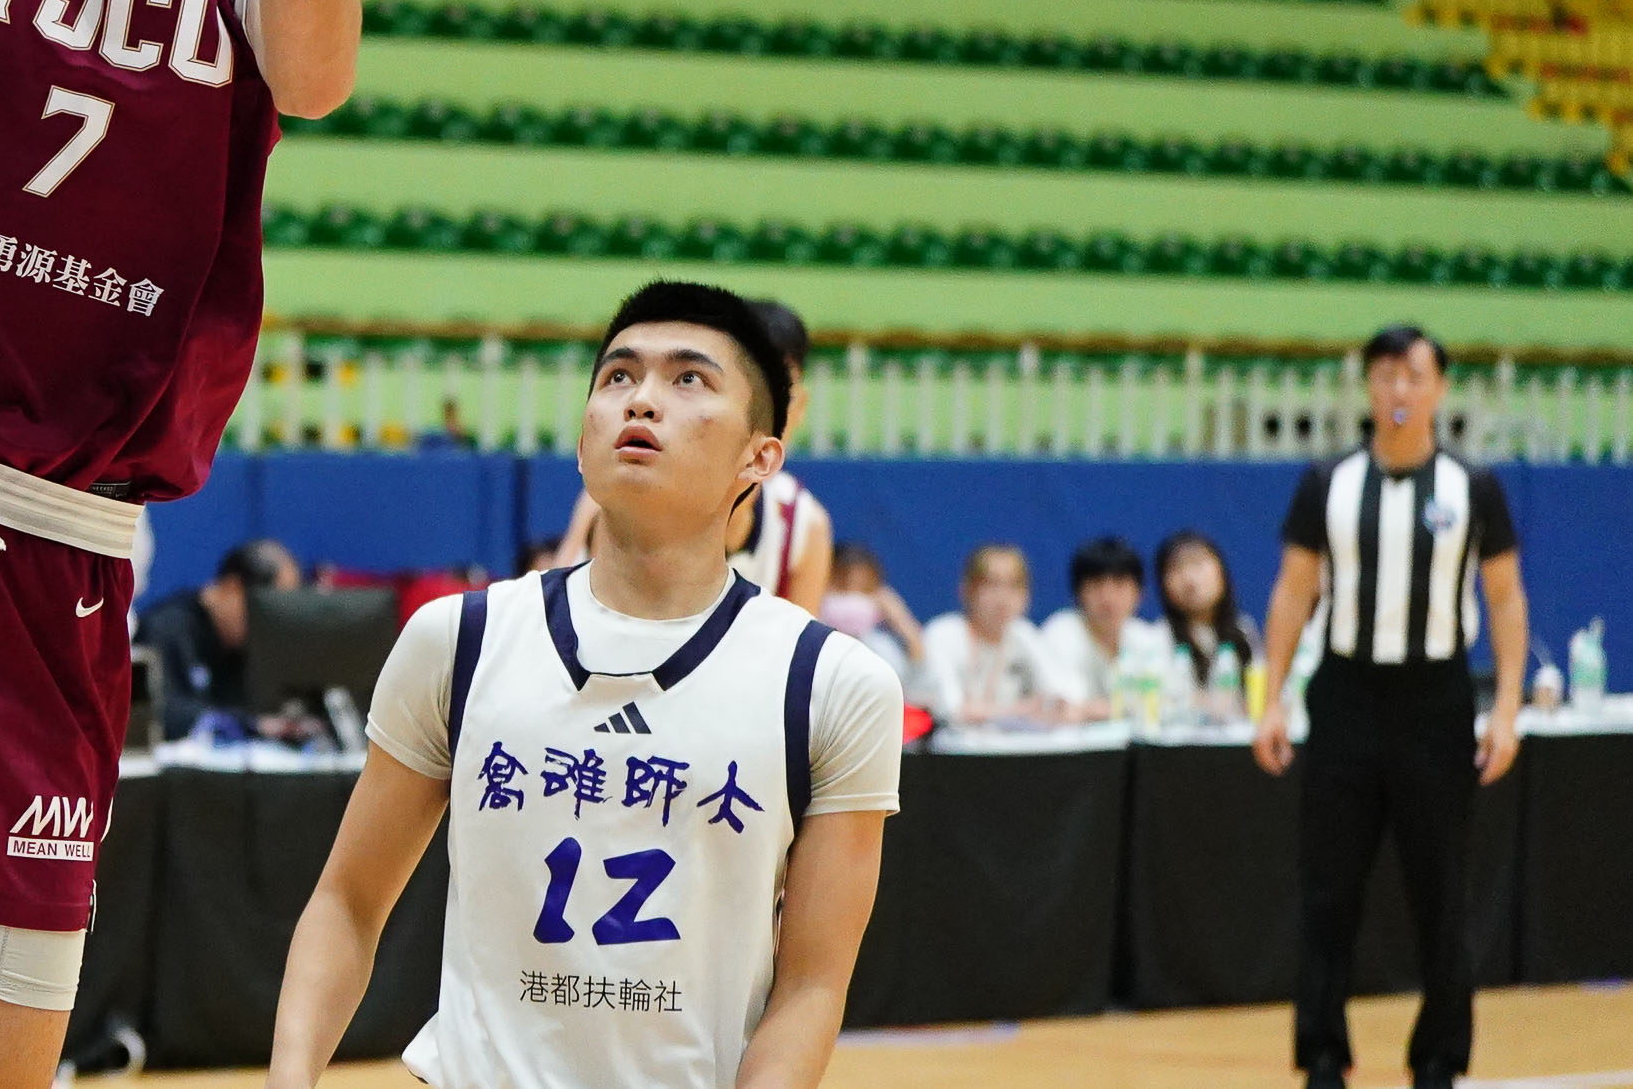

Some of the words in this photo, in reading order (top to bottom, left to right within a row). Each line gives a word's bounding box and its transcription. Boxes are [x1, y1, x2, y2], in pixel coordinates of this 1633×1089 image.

[21, 84, 116, 198] 7
[13, 840, 58, 856] MEAN
[64, 843, 91, 858] WELL
[533, 837, 681, 945] 12
[519, 969, 683, 1013] 港都扶輪社
